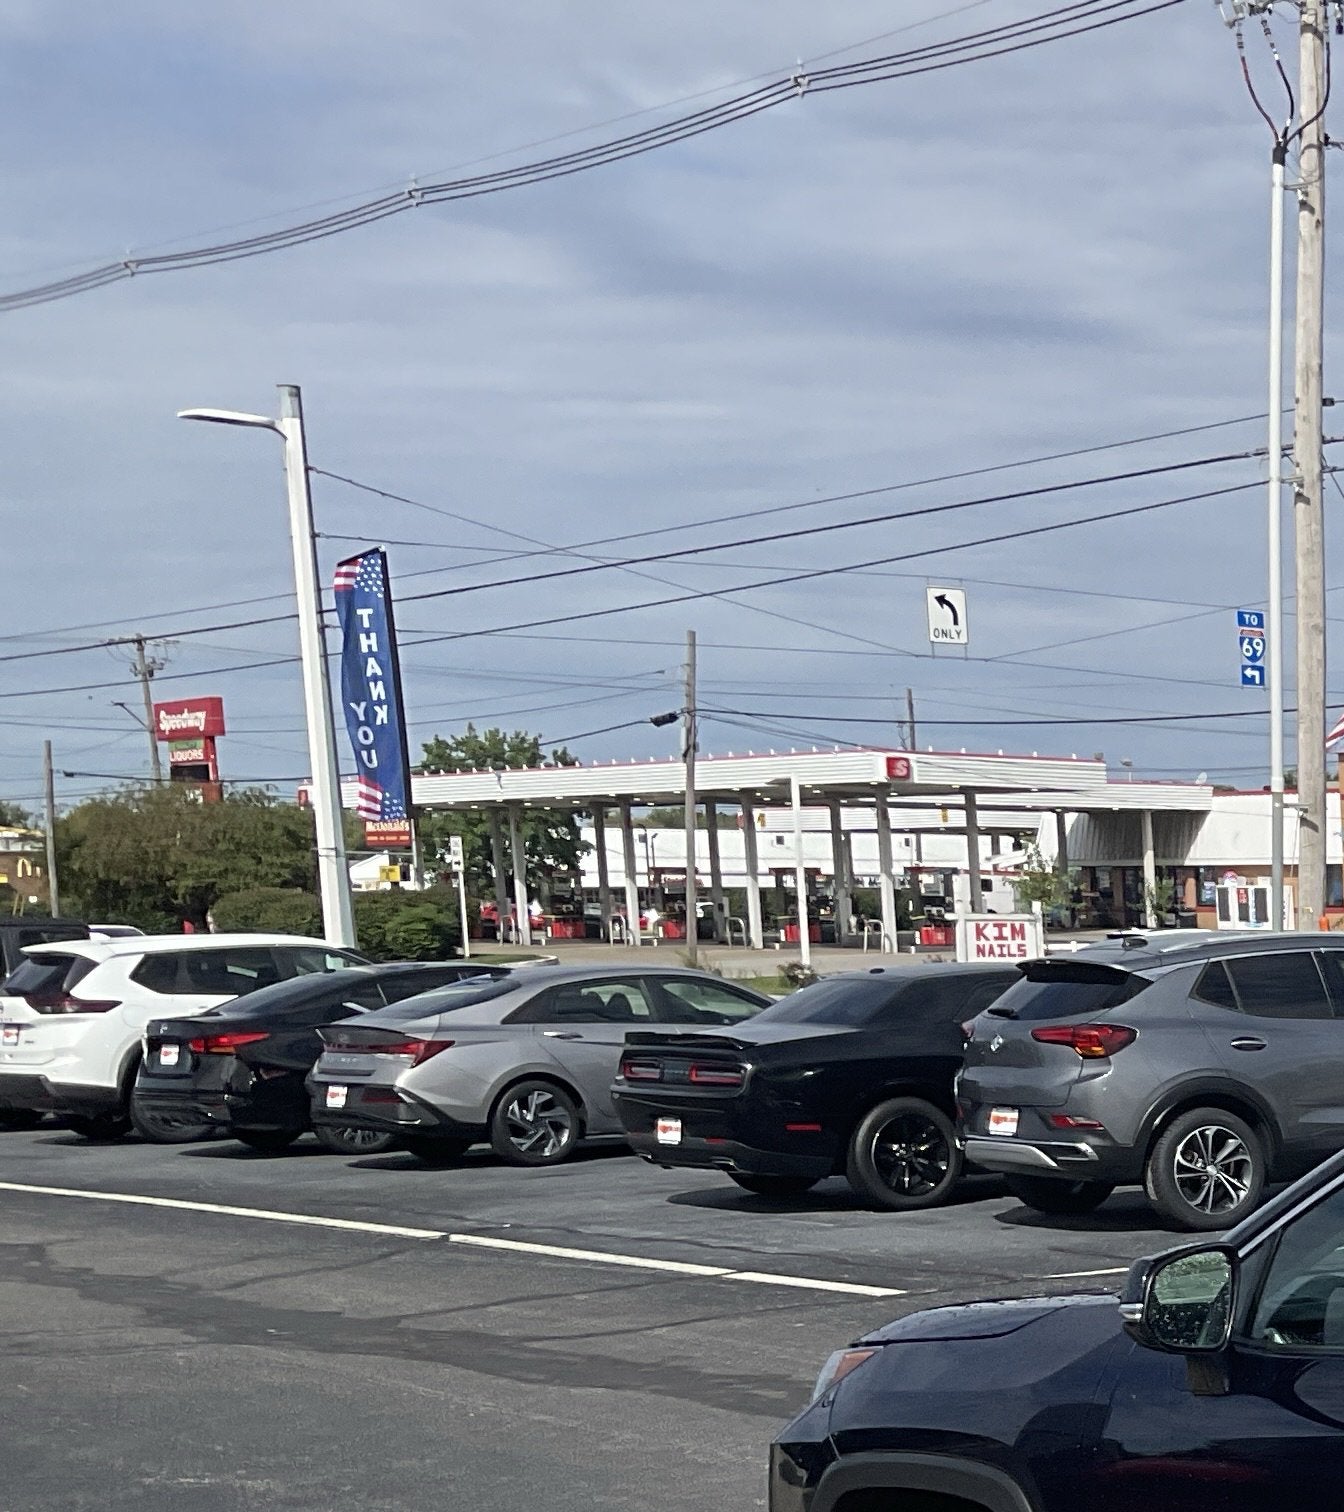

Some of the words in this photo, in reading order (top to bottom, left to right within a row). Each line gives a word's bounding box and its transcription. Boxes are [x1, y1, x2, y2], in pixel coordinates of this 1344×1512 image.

[1243, 614, 1258, 626] TO
[933, 628, 962, 639] ONLY
[1242, 638, 1264, 657] 69
[159, 708, 206, 735] Speedway
[169, 749, 204, 762] LIQUORS
[975, 922, 1026, 941] KIM
[976, 944, 1027, 958] NAILS
